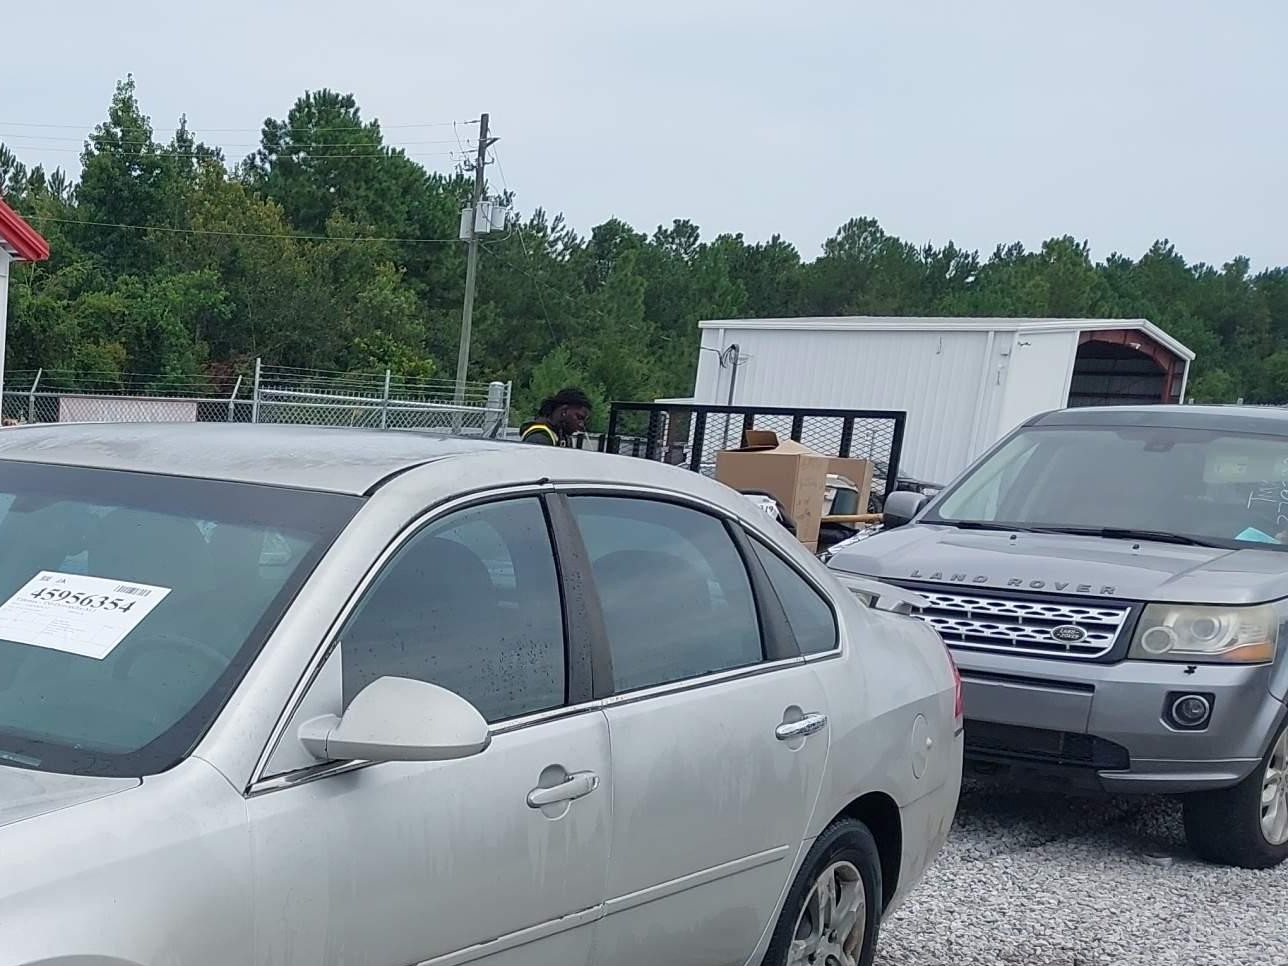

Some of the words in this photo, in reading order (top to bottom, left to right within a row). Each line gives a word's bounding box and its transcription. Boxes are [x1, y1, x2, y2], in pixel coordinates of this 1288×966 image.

[910, 569, 989, 584] LAND
[1006, 577, 1117, 595] ROVER
[30, 587, 137, 613] 45956354
